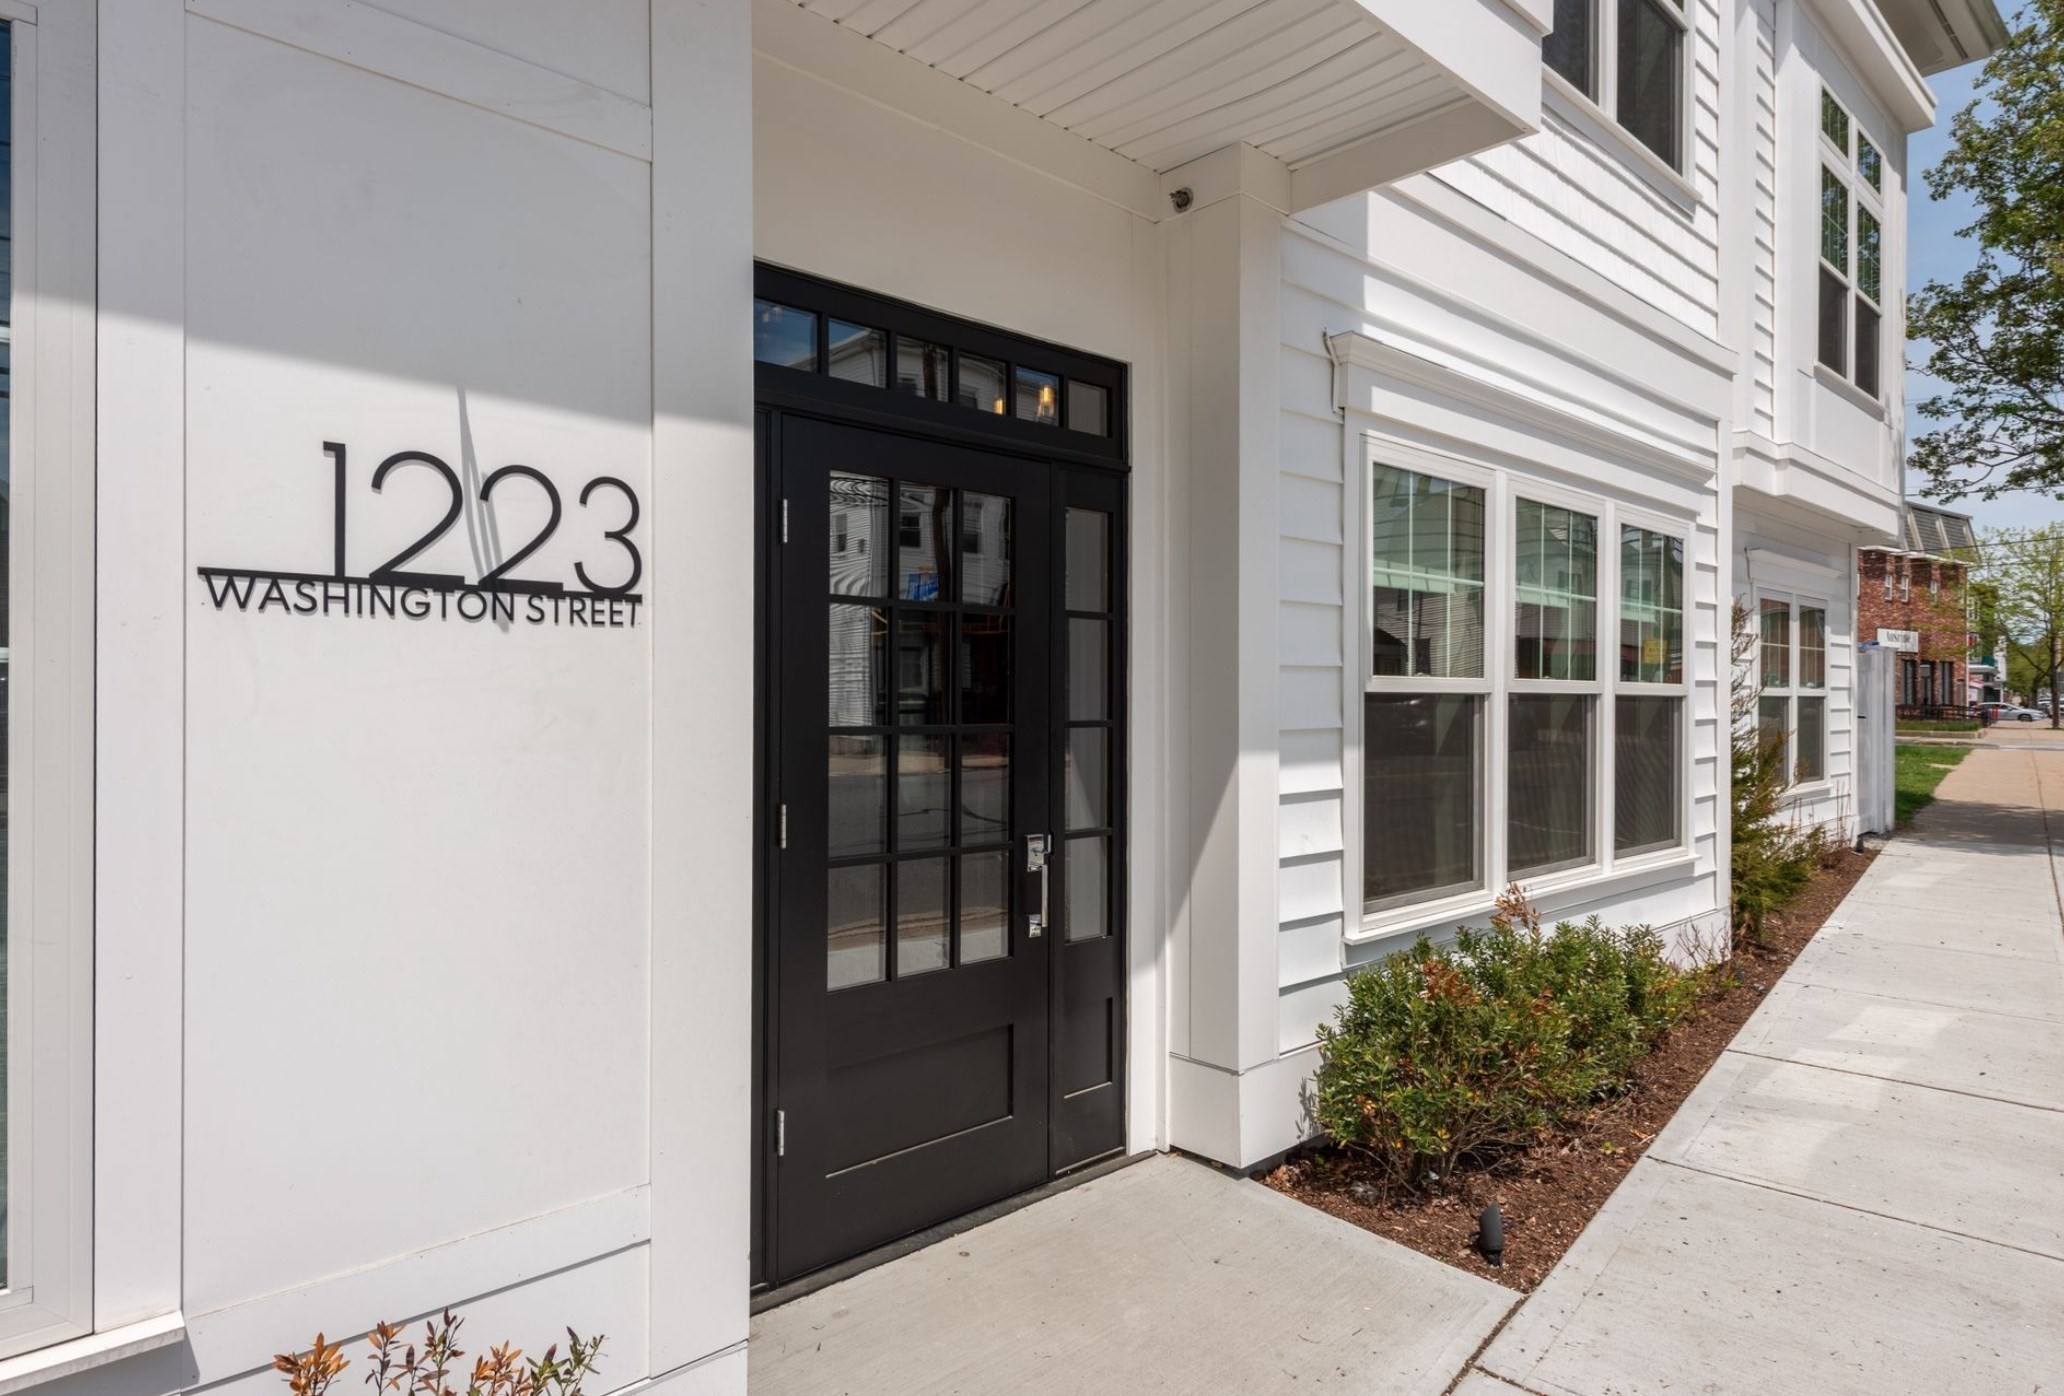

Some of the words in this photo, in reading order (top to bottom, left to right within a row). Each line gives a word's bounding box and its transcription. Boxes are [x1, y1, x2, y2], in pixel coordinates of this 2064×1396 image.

[323, 441, 642, 594] 1223
[203, 573, 515, 621] WASHINGTON
[526, 593, 643, 627] STREET
